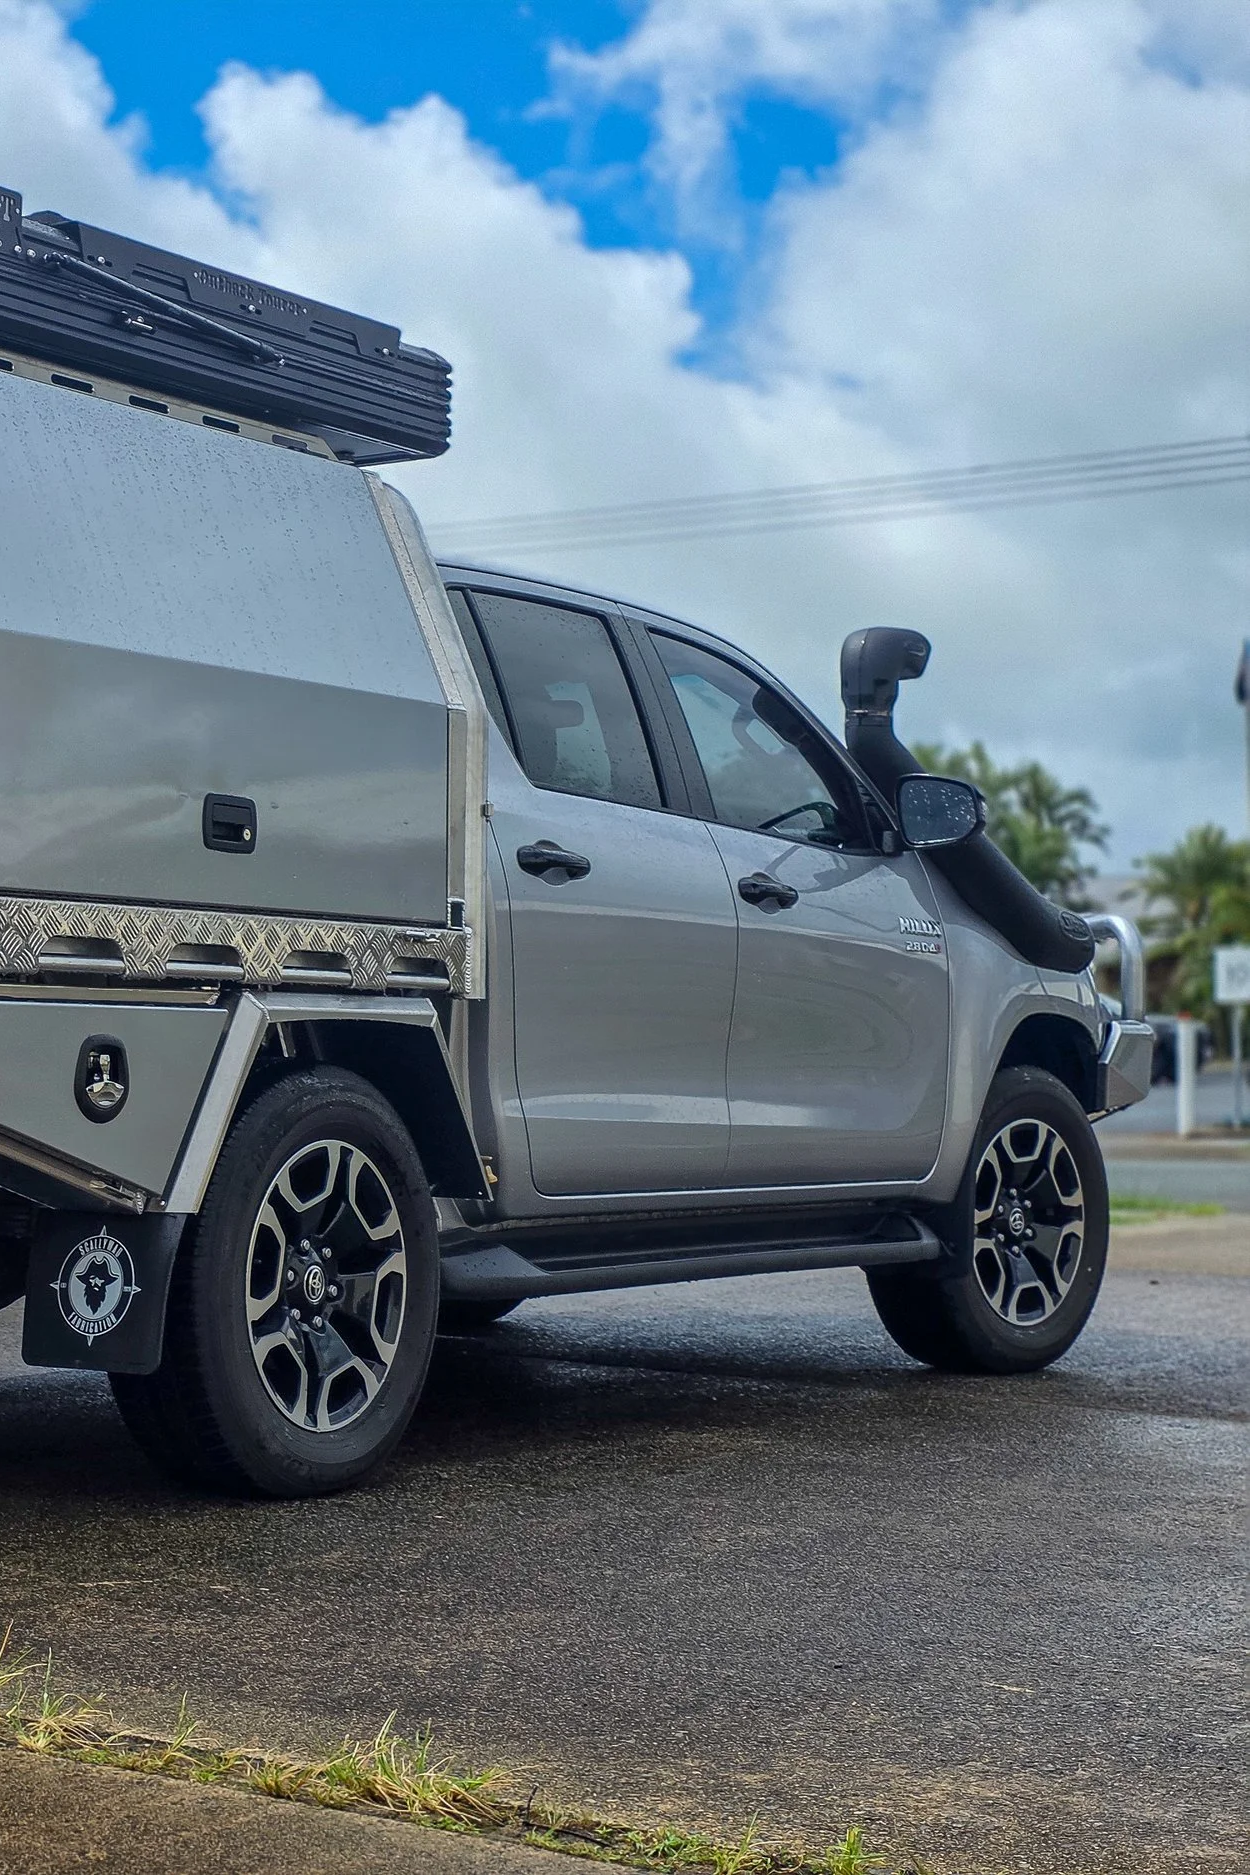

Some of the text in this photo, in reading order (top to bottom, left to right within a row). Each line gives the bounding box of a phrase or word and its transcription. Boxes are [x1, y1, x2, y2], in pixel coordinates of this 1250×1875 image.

[197, 269, 302, 316] Outback Tourer
[898, 916, 942, 937] HILUX
[67, 1312, 117, 1334] FABRICATION
